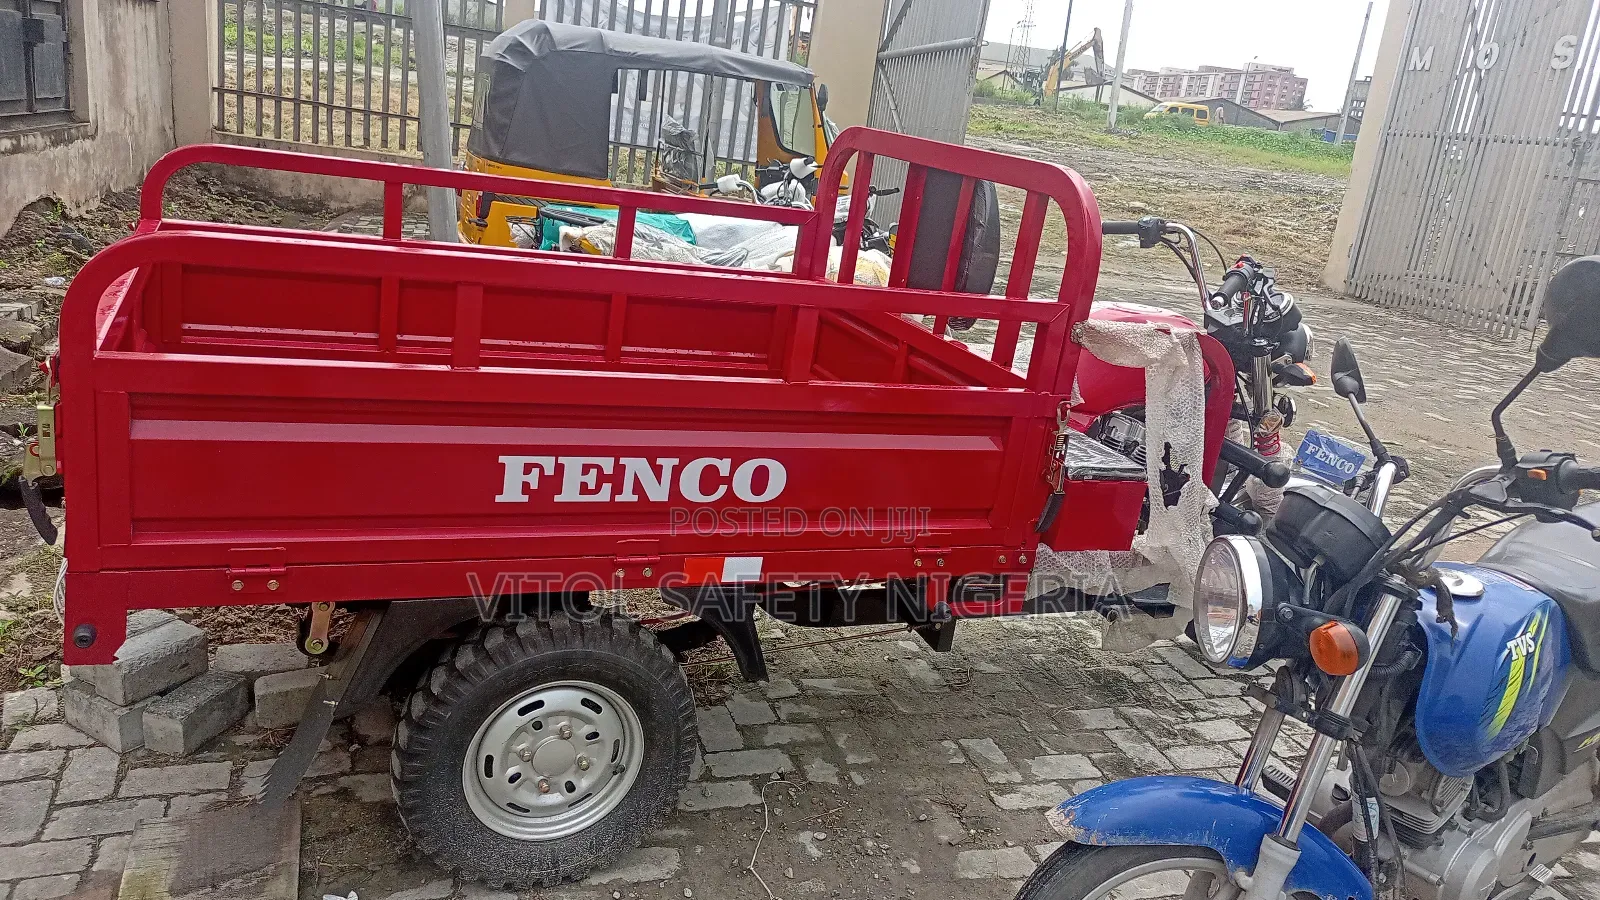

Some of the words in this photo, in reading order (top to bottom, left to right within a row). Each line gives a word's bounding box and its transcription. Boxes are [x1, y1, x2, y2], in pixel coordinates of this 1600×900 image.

[1306, 443, 1355, 474] FENCO
[494, 455, 788, 504] FENCO
[1507, 633, 1535, 660] TVS
